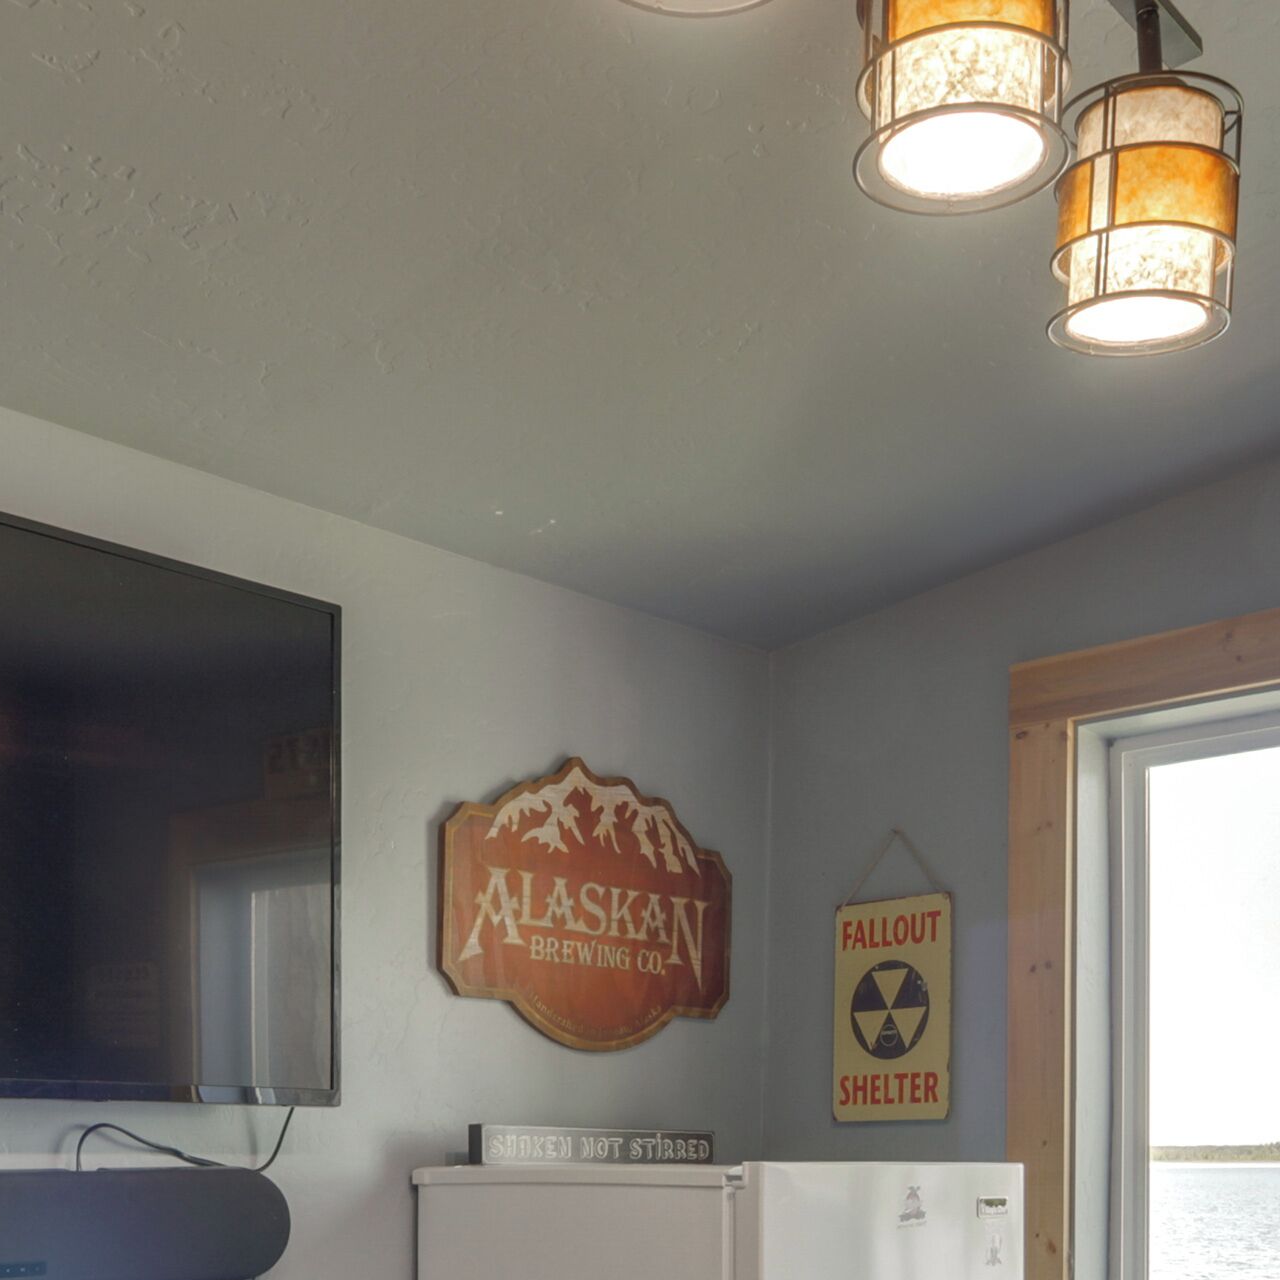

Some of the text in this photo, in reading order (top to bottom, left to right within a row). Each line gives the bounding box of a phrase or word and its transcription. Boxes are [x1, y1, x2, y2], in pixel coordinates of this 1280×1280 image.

[458, 865, 710, 992] ALASKAN
[841, 910, 942, 951] FALLOUT
[529, 935, 666, 976] BREWING CO.
[839, 1071, 940, 1106] SHELTER
[488, 1134, 572, 1160] SHAKEN
[580, 1136, 623, 1160] NOT
